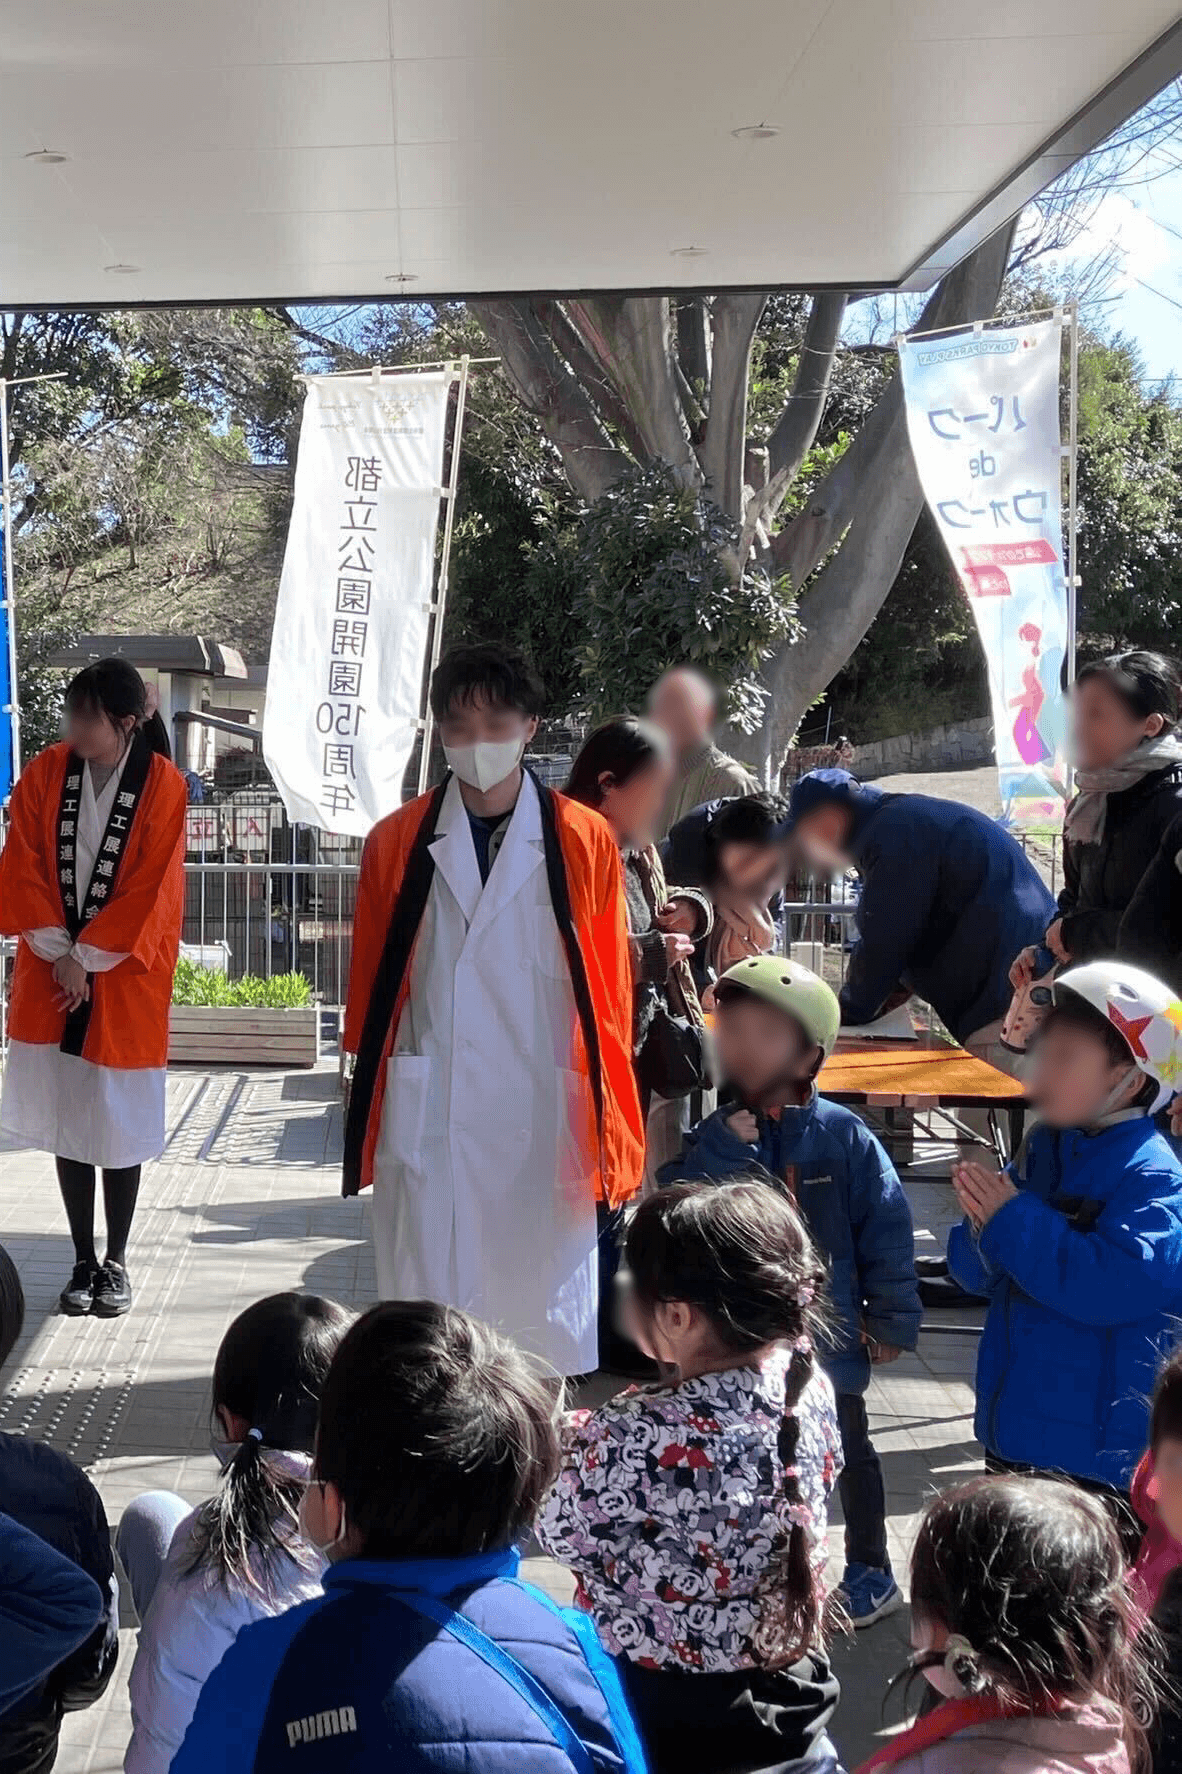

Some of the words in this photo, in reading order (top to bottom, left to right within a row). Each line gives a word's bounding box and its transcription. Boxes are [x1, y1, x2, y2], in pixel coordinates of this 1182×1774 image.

[60, 774, 81, 907] 理工展連絡会
[85, 791, 136, 919] 理工展連絡会
[286, 1705, 357, 1749] PUMA
